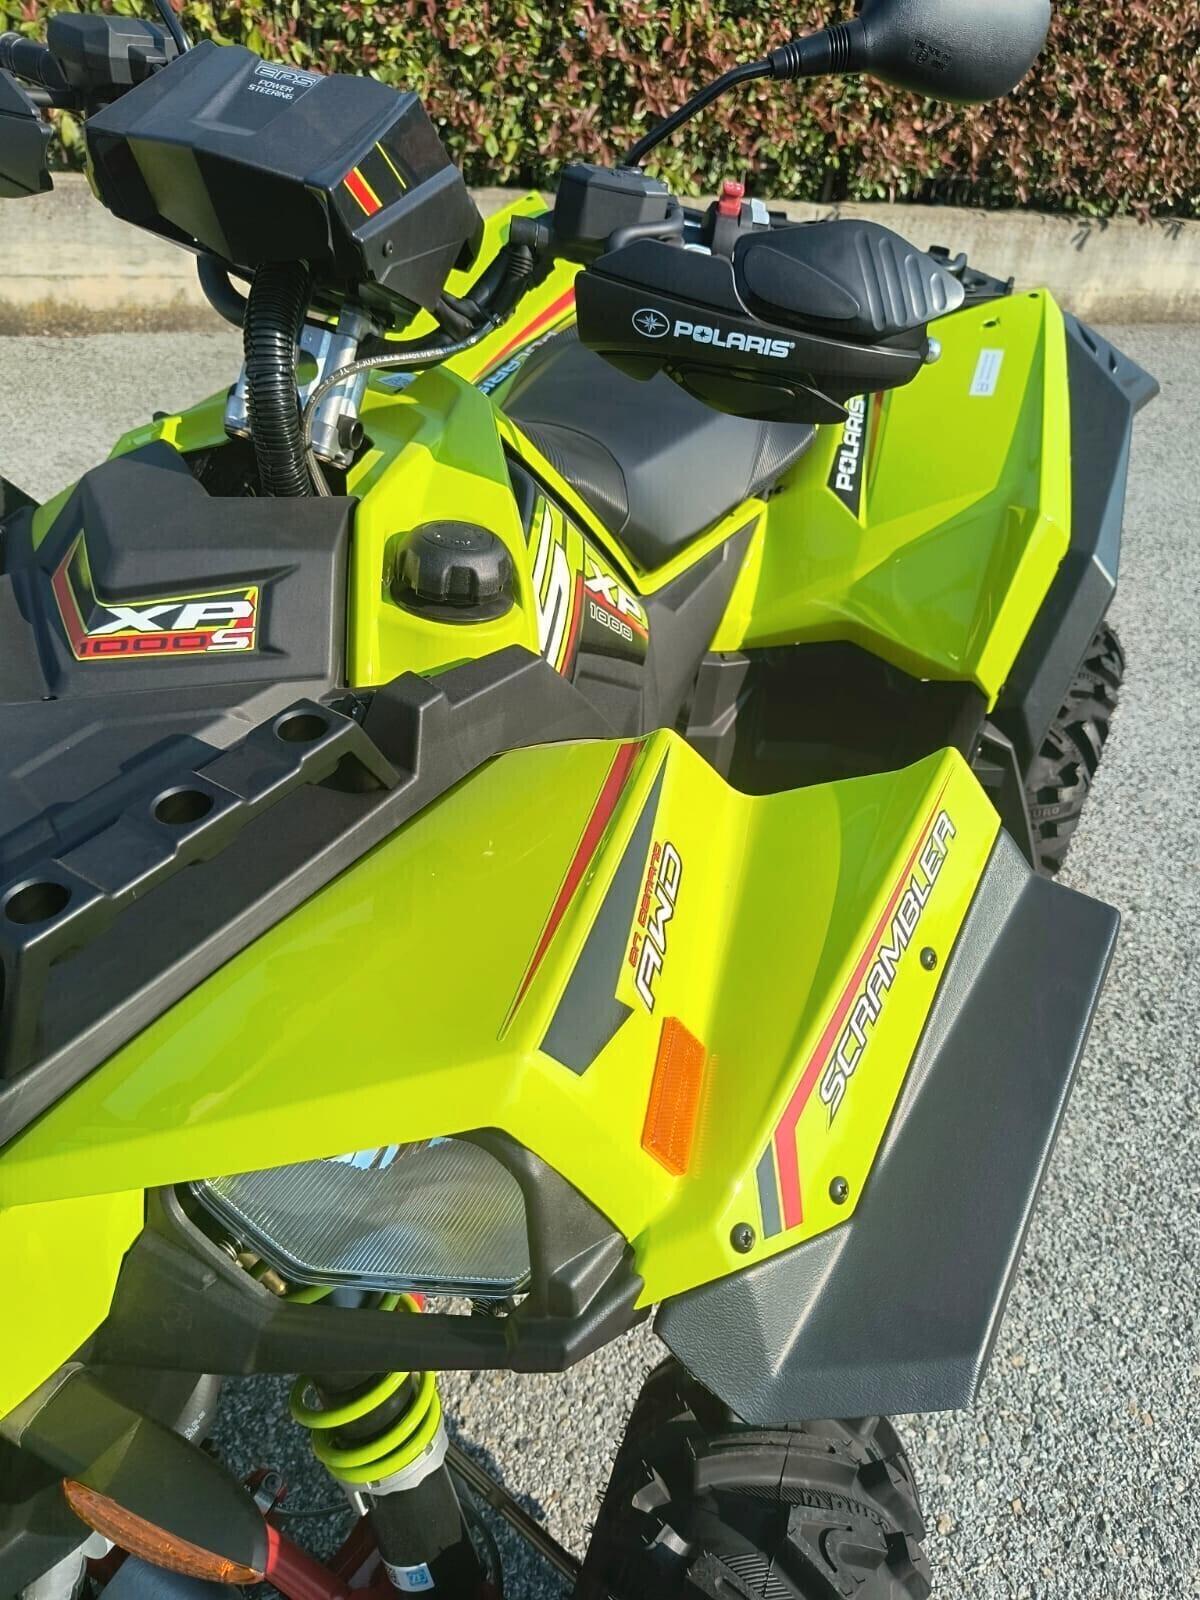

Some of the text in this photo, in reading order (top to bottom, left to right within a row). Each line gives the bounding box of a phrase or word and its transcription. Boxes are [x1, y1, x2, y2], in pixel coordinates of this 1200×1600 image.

[247, 83, 294, 100] STEERING
[254, 65, 316, 88] EPS
[258, 79, 295, 93] POWER
[673, 320, 793, 358] POLARIS
[835, 399, 866, 491] POLARIS
[584, 556, 642, 621] XP
[87, 600, 255, 636] XP
[590, 602, 633, 642] 1000
[635, 840, 683, 1015] AWD
[819, 809, 956, 1130] SCRAMBLER
